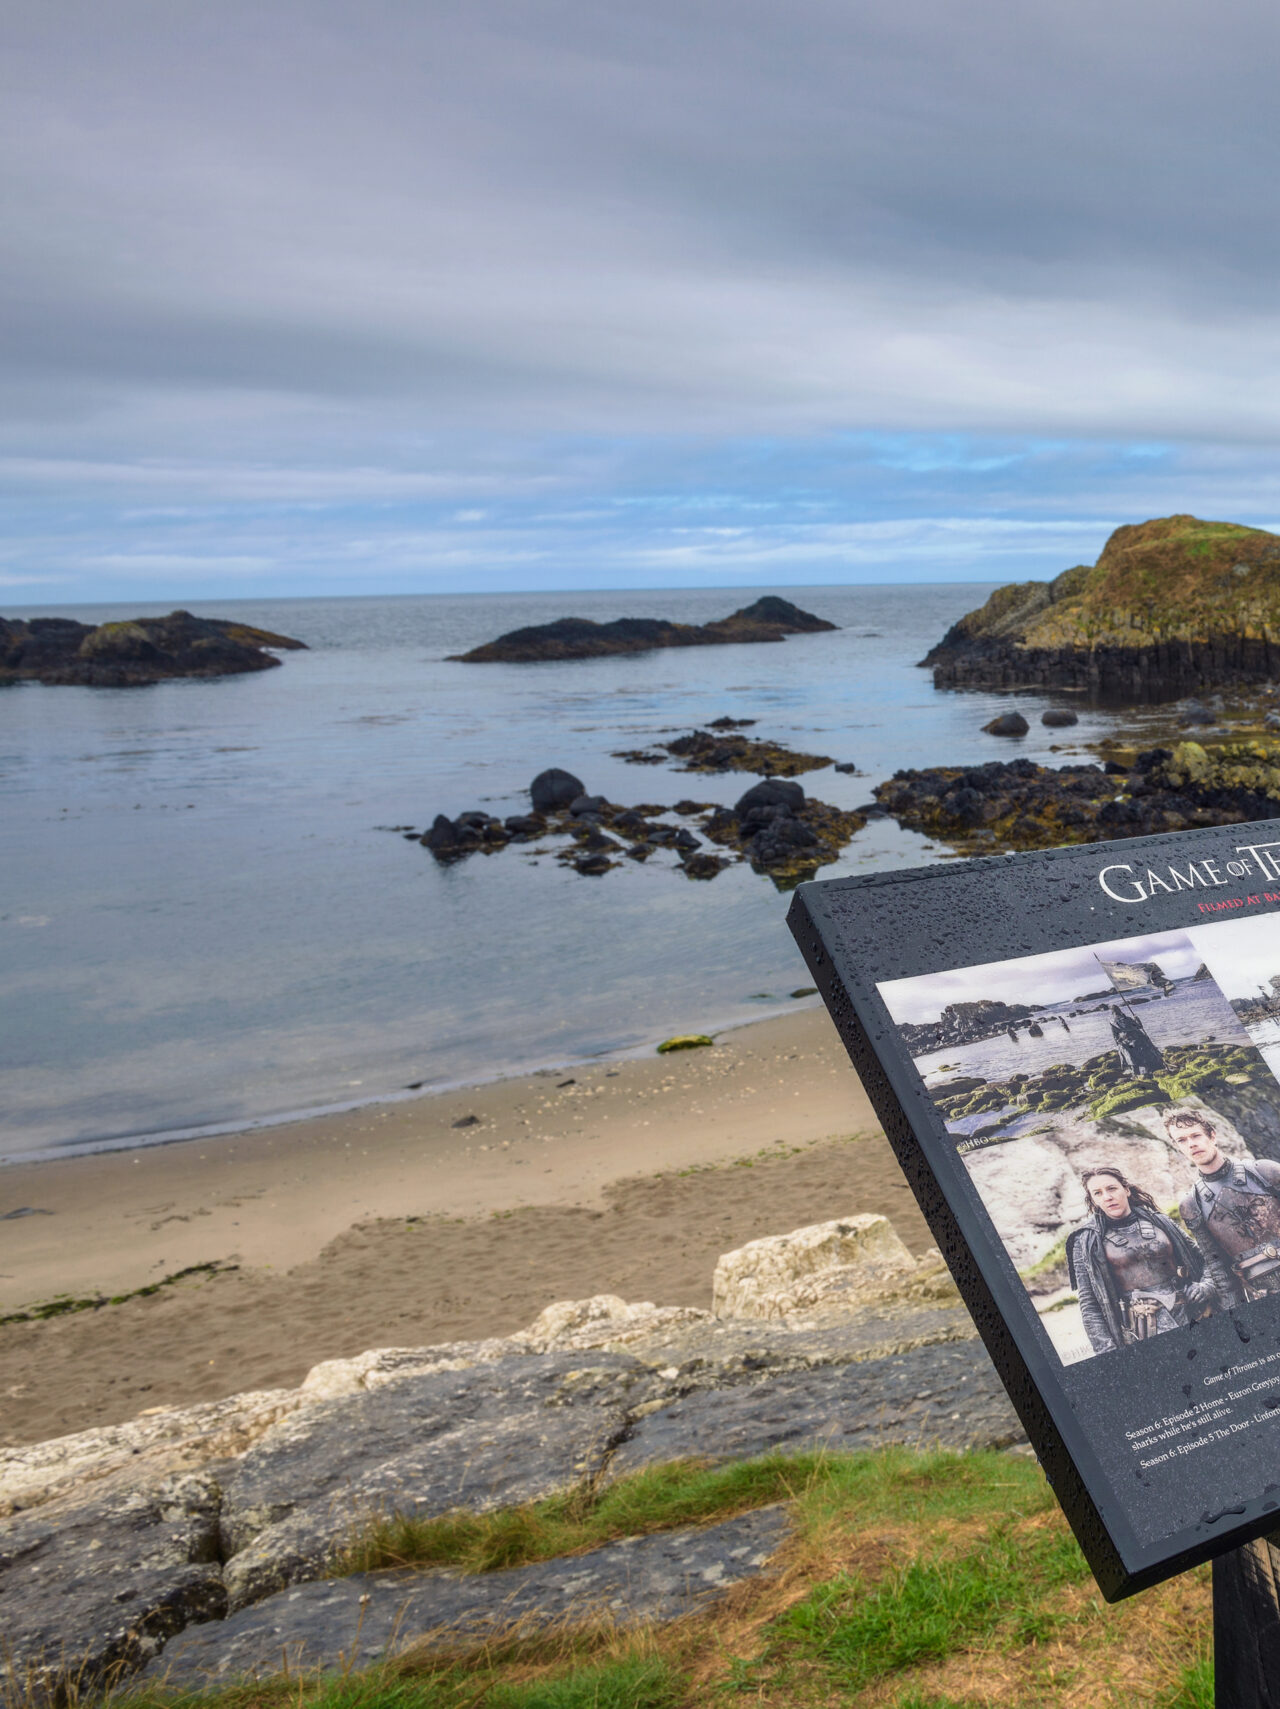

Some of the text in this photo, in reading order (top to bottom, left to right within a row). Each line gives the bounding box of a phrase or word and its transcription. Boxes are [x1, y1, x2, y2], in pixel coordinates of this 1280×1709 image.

[1099, 859, 1228, 903] GAME
[1226, 858, 1254, 877] OF
[1197, 897, 1243, 913] FILMED
[1247, 895, 1262, 905] AT
[1202, 1371, 1224, 1385] Game
[1222, 1368, 1233, 1378] of
[1230, 1358, 1259, 1375] Thrones
[1257, 1356, 1266, 1364] is
[1265, 1354, 1276, 1362] an
[1124, 1422, 1155, 1440] Season
[1153, 1419, 1163, 1429] 6:
[1161, 1407, 1195, 1428] Episode
[1192, 1405, 1200, 1414] 2
[1199, 1395, 1224, 1411] Home
[1227, 1385, 1252, 1400] Euron
[1130, 1404, 1233, 1451] sharks while he's still alive.
[1139, 1450, 1169, 1468] Season
[1167, 1447, 1177, 1457] 6:
[1176, 1434, 1210, 1455] Episode
[1207, 1432, 1215, 1441] 5
[1213, 1426, 1230, 1438] The
[1228, 1418, 1250, 1432] Door
